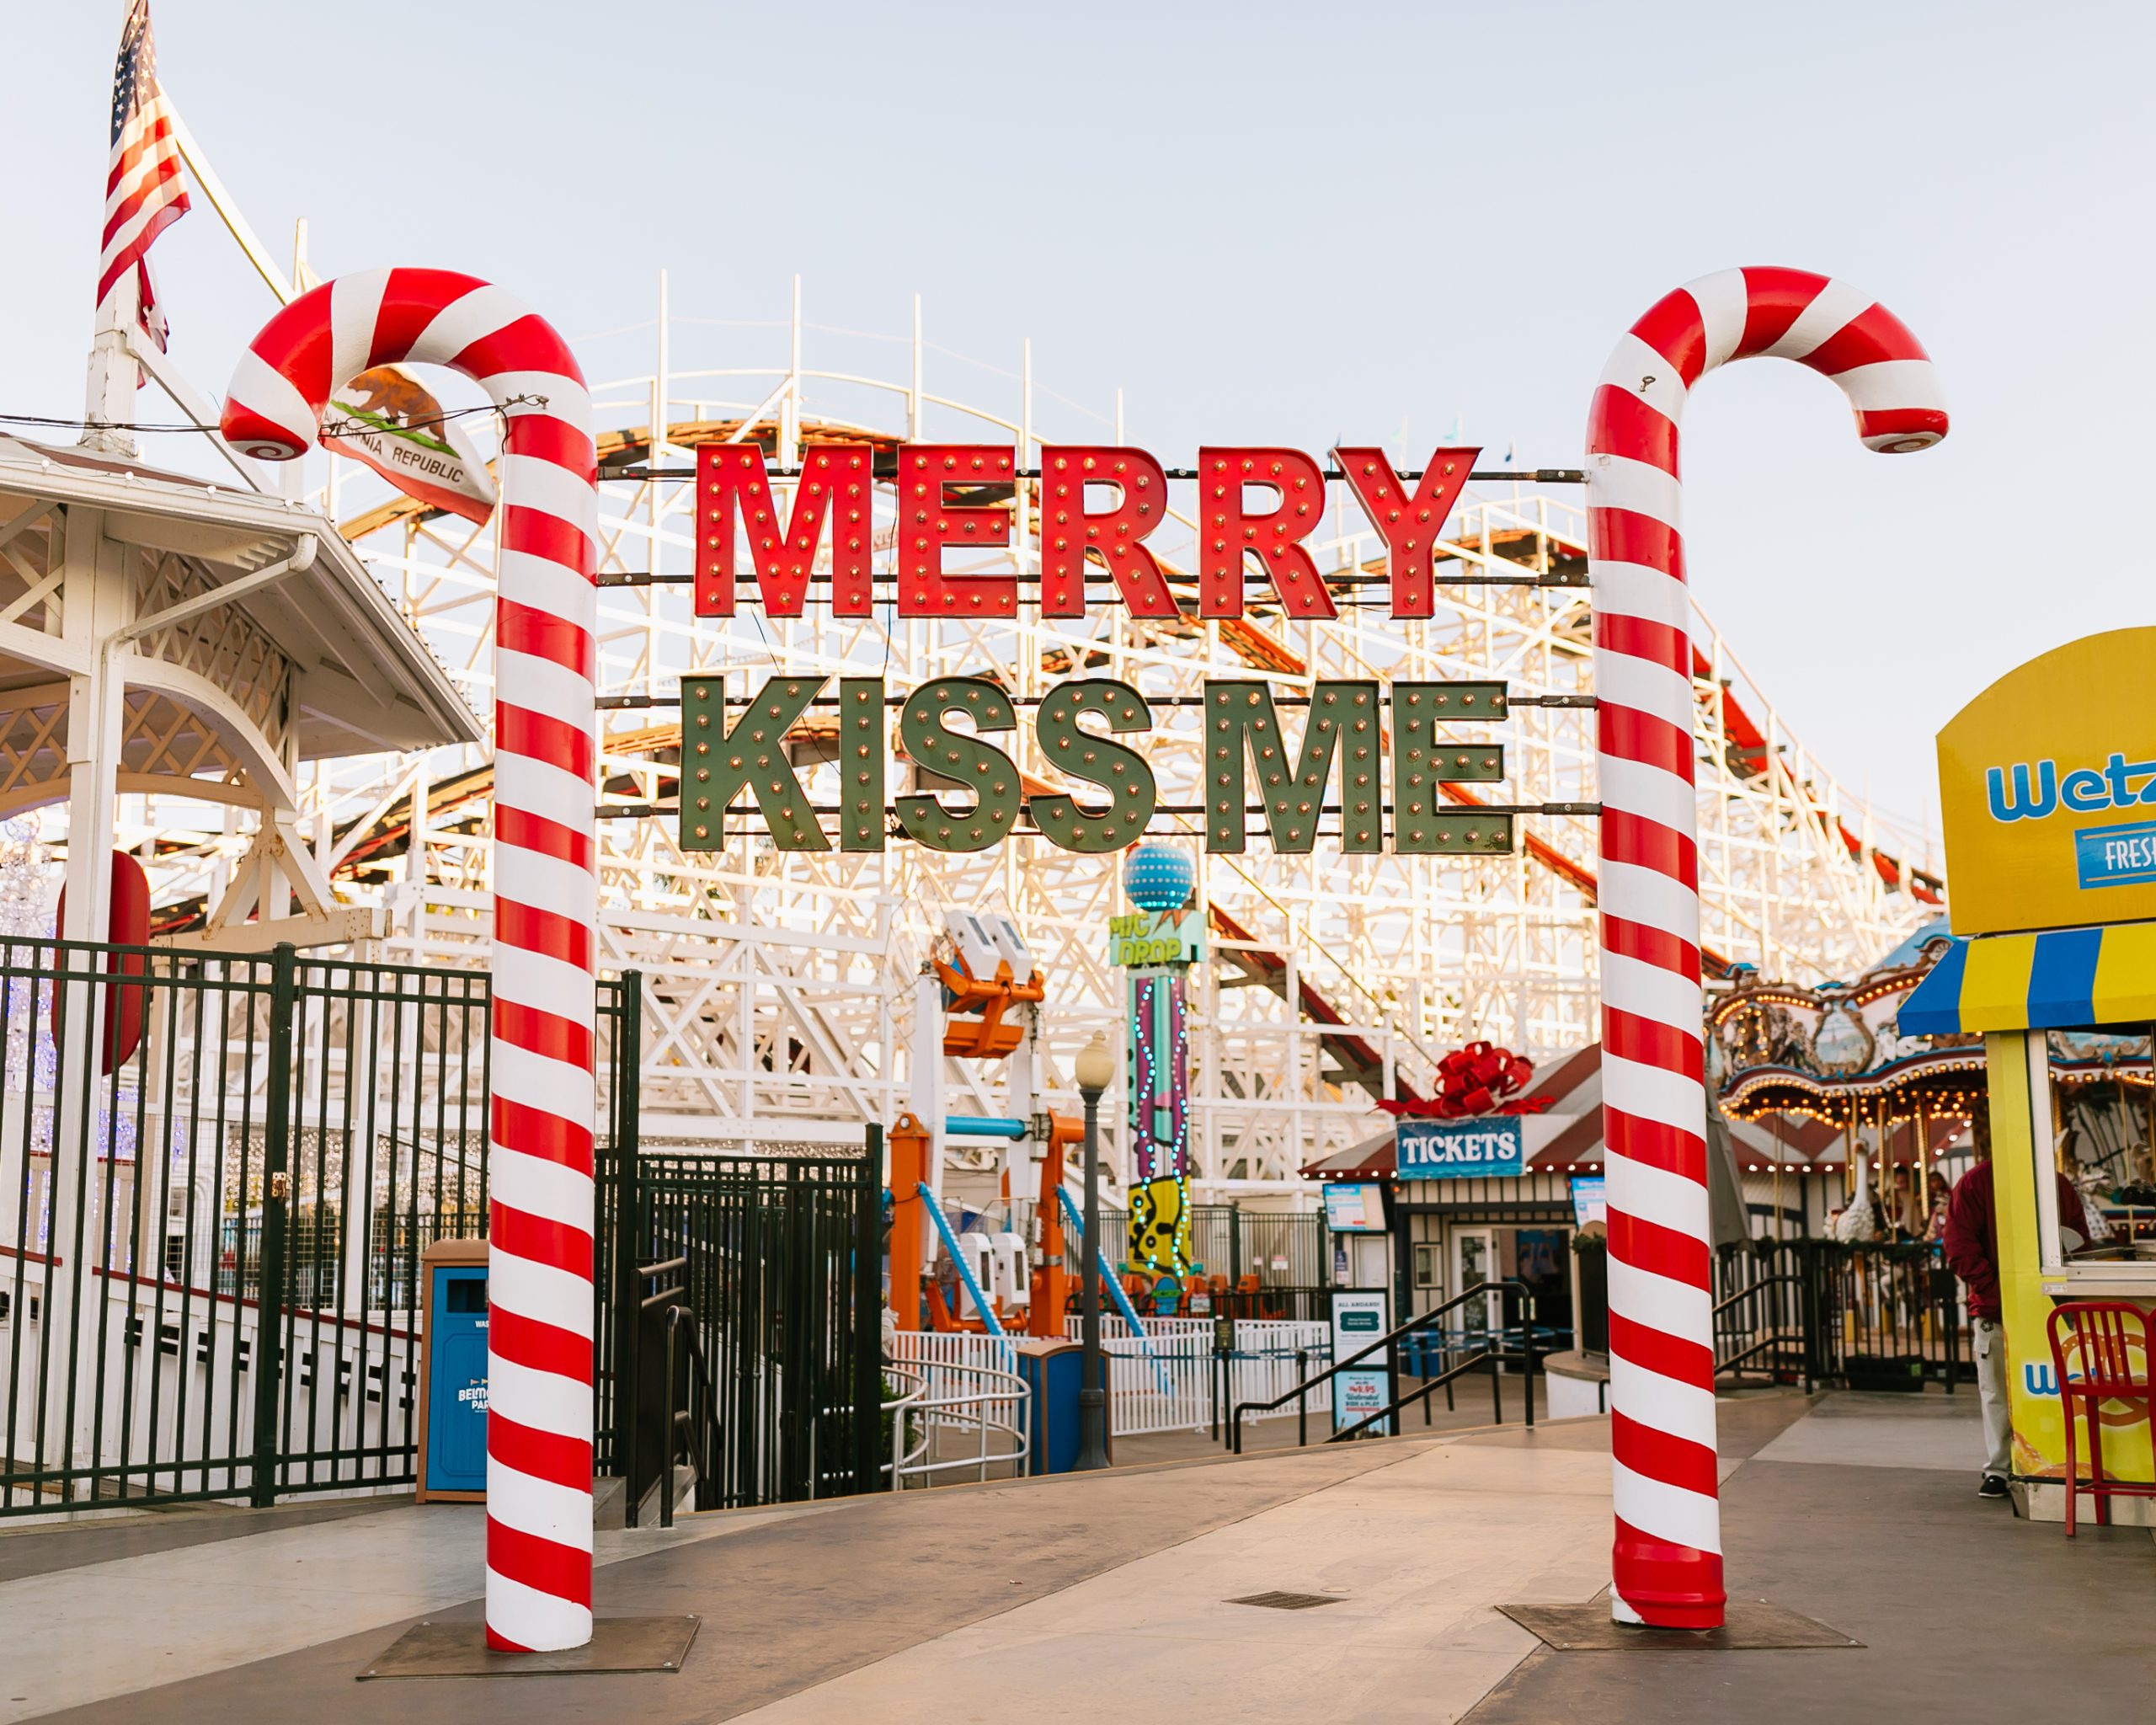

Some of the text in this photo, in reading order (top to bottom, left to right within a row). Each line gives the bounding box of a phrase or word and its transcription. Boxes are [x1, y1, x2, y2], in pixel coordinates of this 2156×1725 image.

[392, 446, 464, 483] REPUBLIC
[694, 442, 1482, 620] MERRY
[679, 675, 1514, 855] KISS ME
[1109, 913, 1150, 939] MIC
[1118, 937, 1181, 964] DROP
[1402, 1131, 1517, 1164] TICKETS
[458, 1387, 488, 1402] BELM
